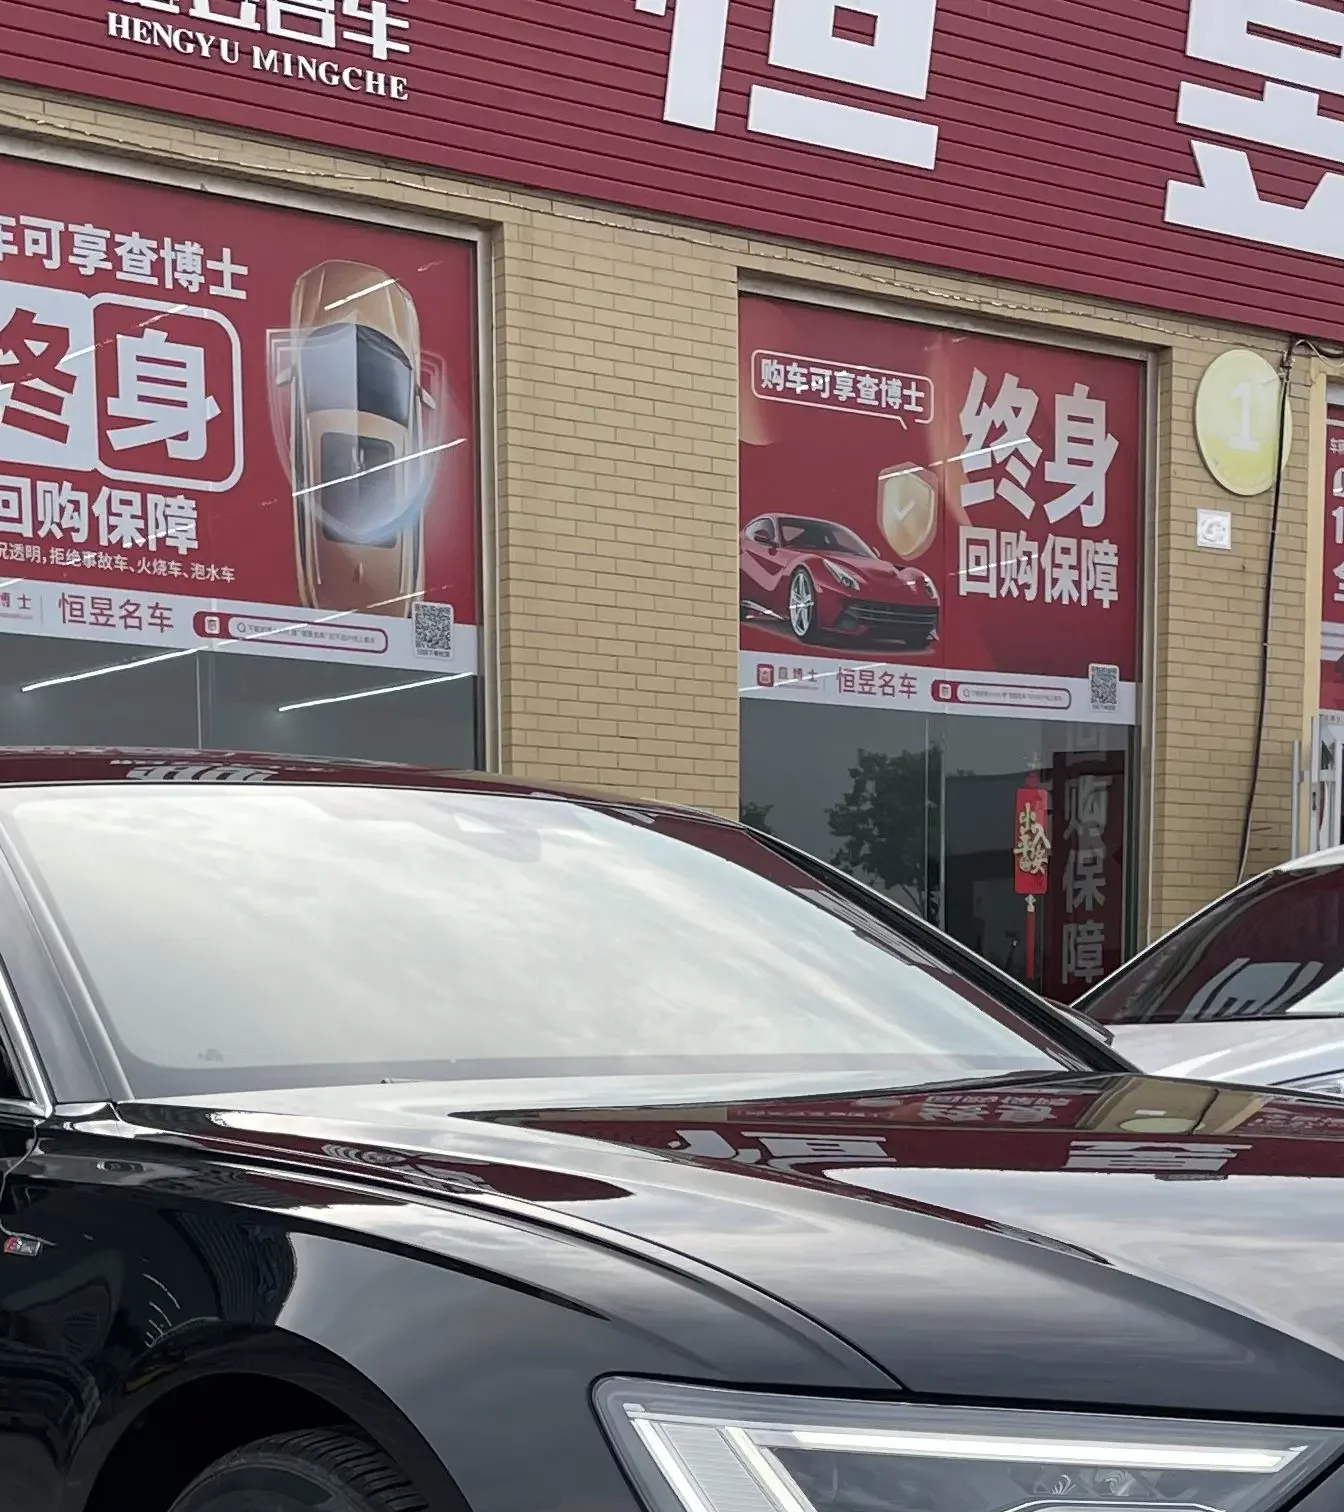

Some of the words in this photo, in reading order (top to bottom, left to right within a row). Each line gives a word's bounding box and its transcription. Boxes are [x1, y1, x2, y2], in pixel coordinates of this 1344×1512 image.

[107, 12, 240, 64] HENGYU
[252, 45, 409, 101] MINGCHE
[761, 358, 925, 413] 购车可享查博士
[958, 368, 1121, 528] 终身
[958, 524, 1120, 609] 回购保障
[57, 591, 175, 634] 恒昱名车
[836, 666, 918, 700] 恒昱名车
